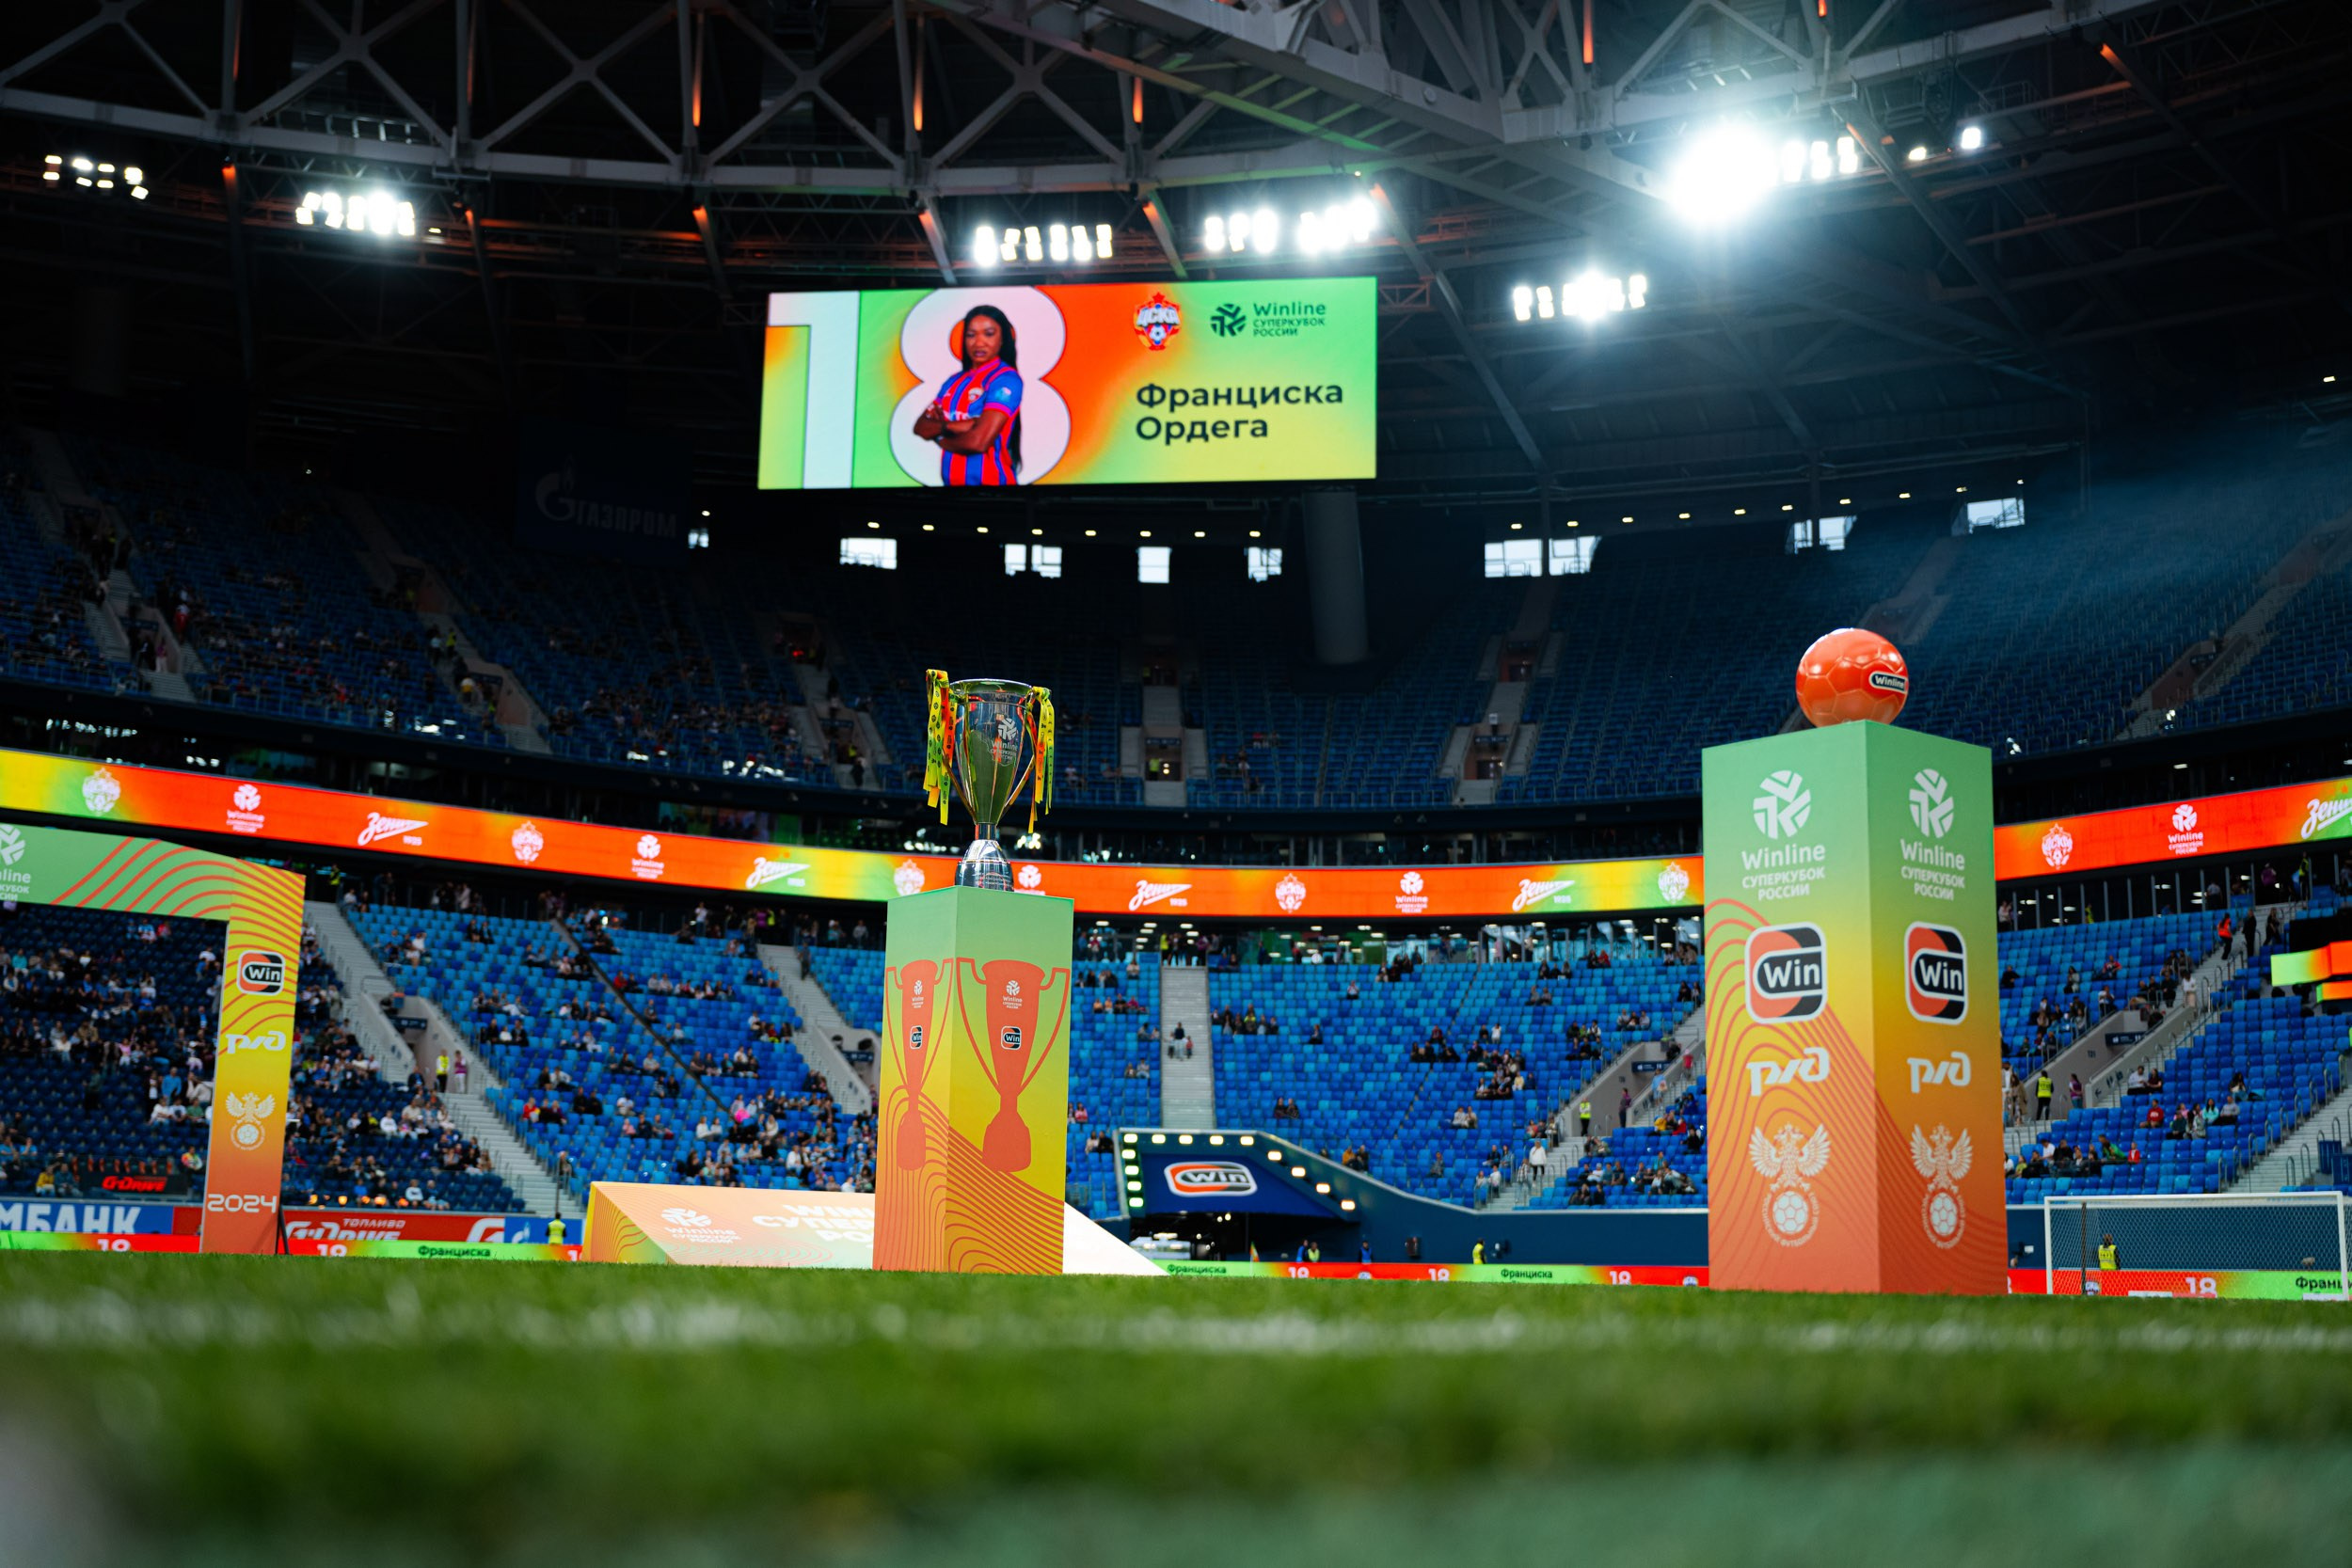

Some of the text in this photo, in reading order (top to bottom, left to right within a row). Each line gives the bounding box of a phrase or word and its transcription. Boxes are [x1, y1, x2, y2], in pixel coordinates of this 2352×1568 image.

[1253, 302, 1326, 316] Winline
[1253, 317, 1325, 328] СУПЕРКУБОК
[1253, 328, 1298, 338] РОССИИ
[768, 285, 1071, 488] 18
[1136, 383, 1343, 413] Франциска
[1136, 417, 1268, 446] Ордега
[1874, 674, 1904, 689] Winline
[2168, 832, 2204, 844] Winline
[1741, 844, 1826, 871] Winline
[1900, 839, 1965, 871] Winline
[1741, 866, 1825, 889] СУПЕРКУБОК
[1900, 864, 1965, 889] СУПЕРКУБОК
[1757, 884, 1810, 901] РОССИИ
[1914, 882, 1954, 901] РОССИИ
[248, 966, 282, 981] Win
[1763, 959, 1821, 990] Win
[1919, 958, 1963, 991] Win
[1006, 1034, 1020, 1042] Win
[1185, 1171, 1250, 1183] Win
[207, 1194, 278, 1213] 2024
[783, 1204, 875, 1219] WIN
[664, 1227, 737, 1236] Winline
[418, 1245, 491, 1258] Франциска
[1168, 1263, 1227, 1275] Франциска
[1501, 1268, 1553, 1279] Франциска
